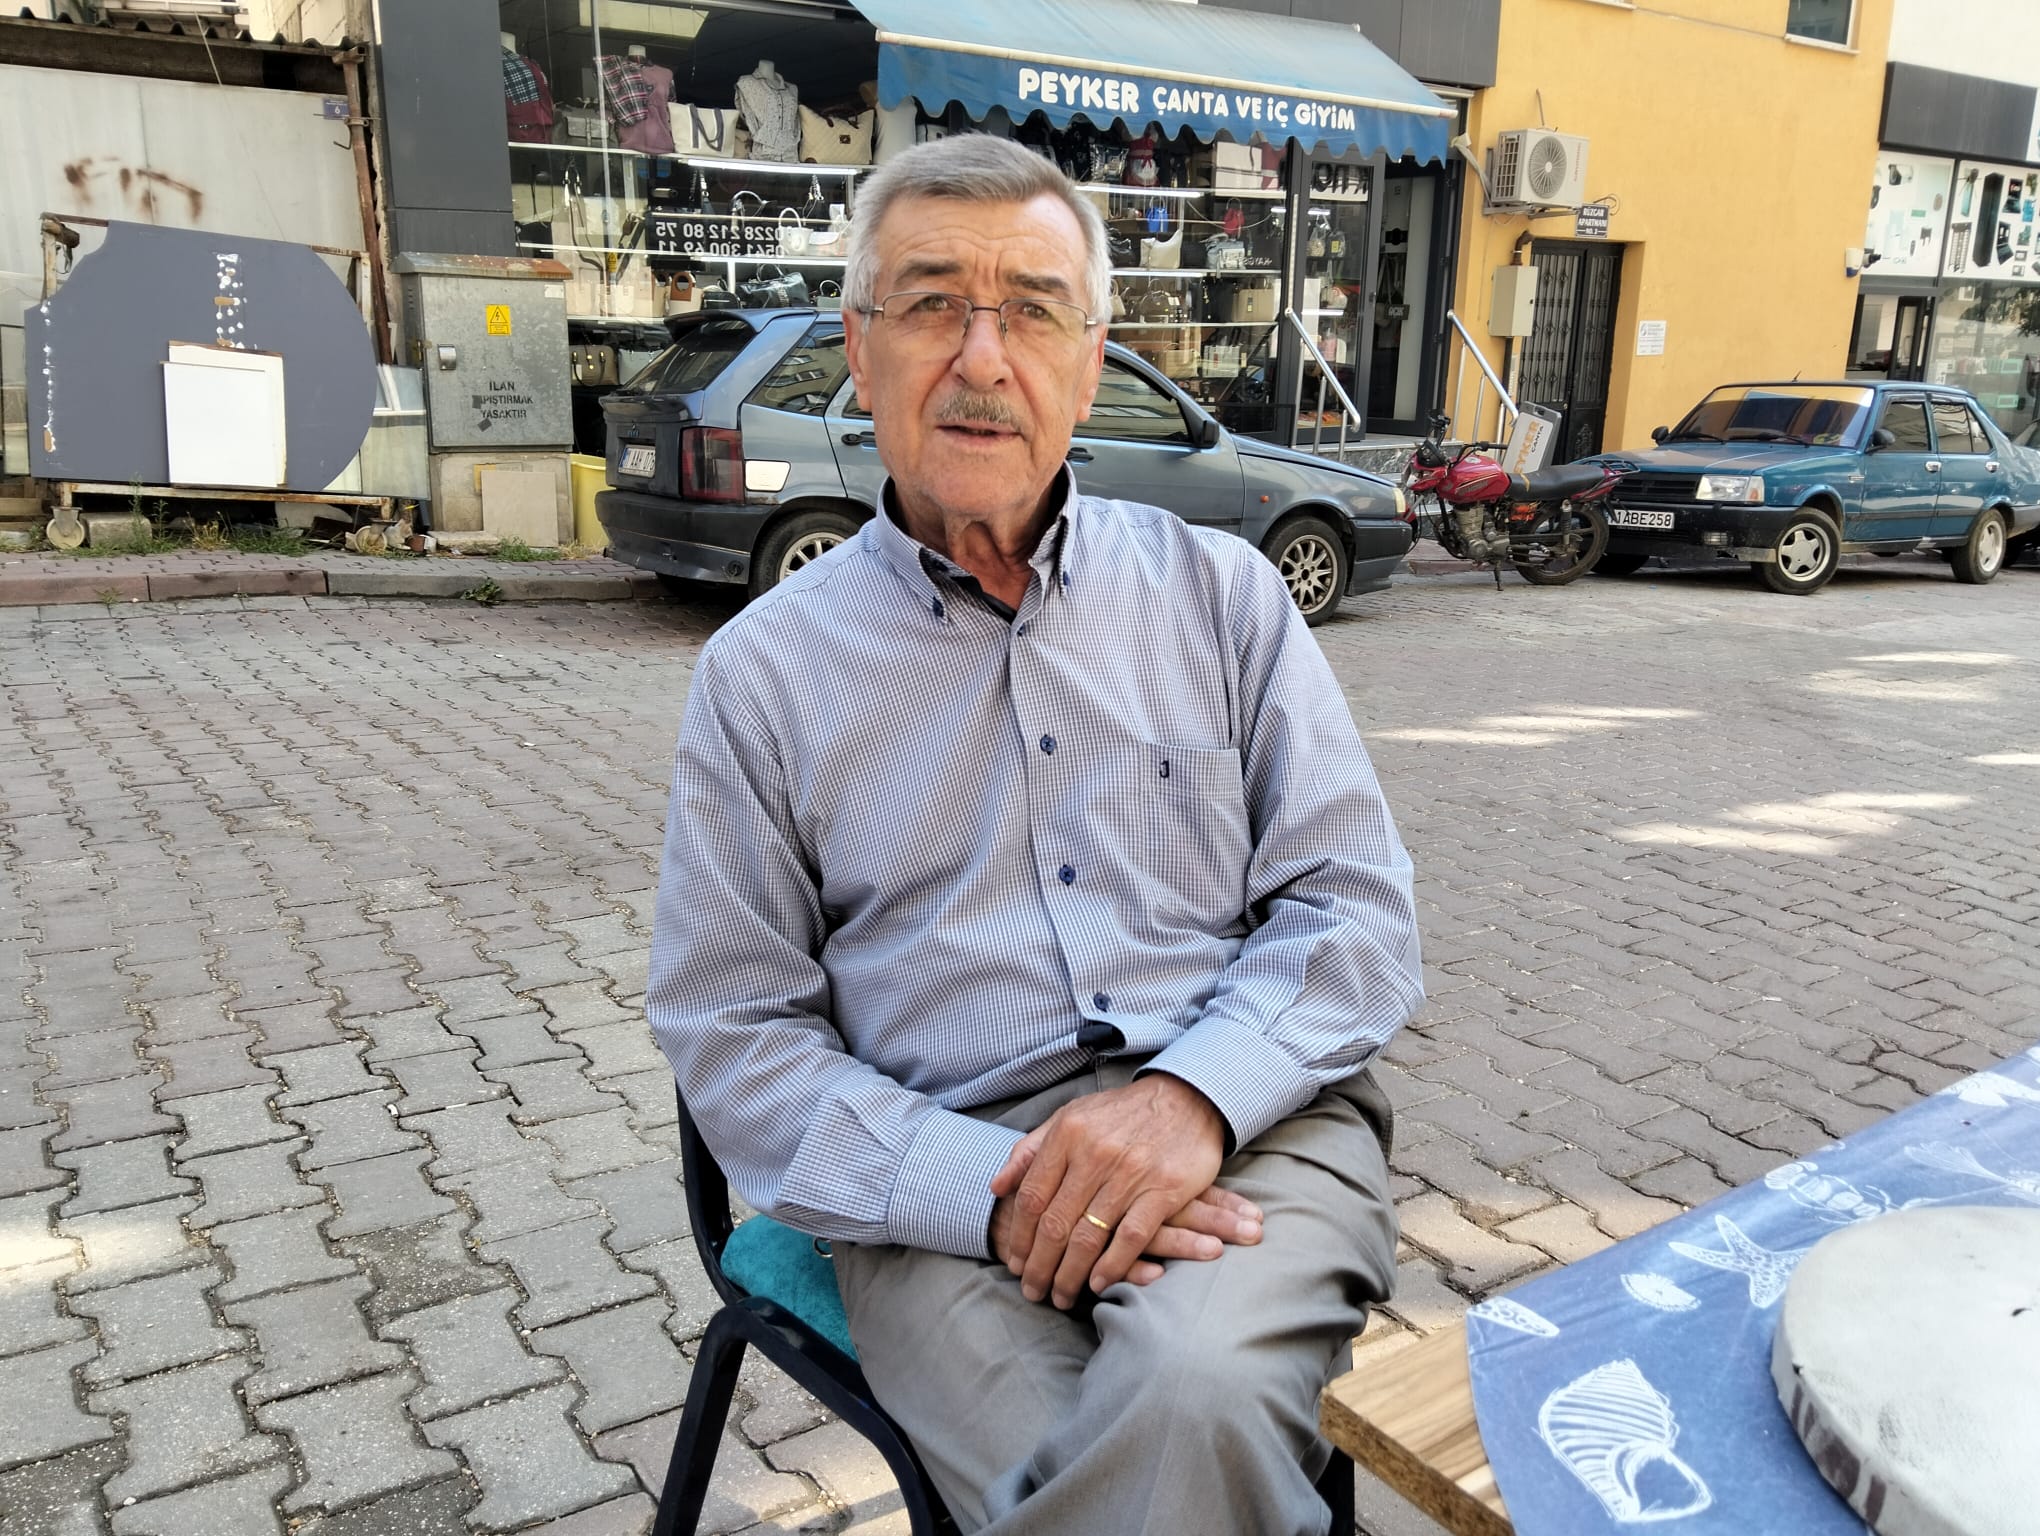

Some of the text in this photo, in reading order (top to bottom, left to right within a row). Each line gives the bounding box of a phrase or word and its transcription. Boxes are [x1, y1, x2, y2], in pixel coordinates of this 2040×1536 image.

[1018, 68, 1139, 113] PEYKER
[1152, 86, 1229, 116] ÇANTA
[1235, 95, 1262, 120] VE
[481, 409, 527, 419] YASAKTIR
